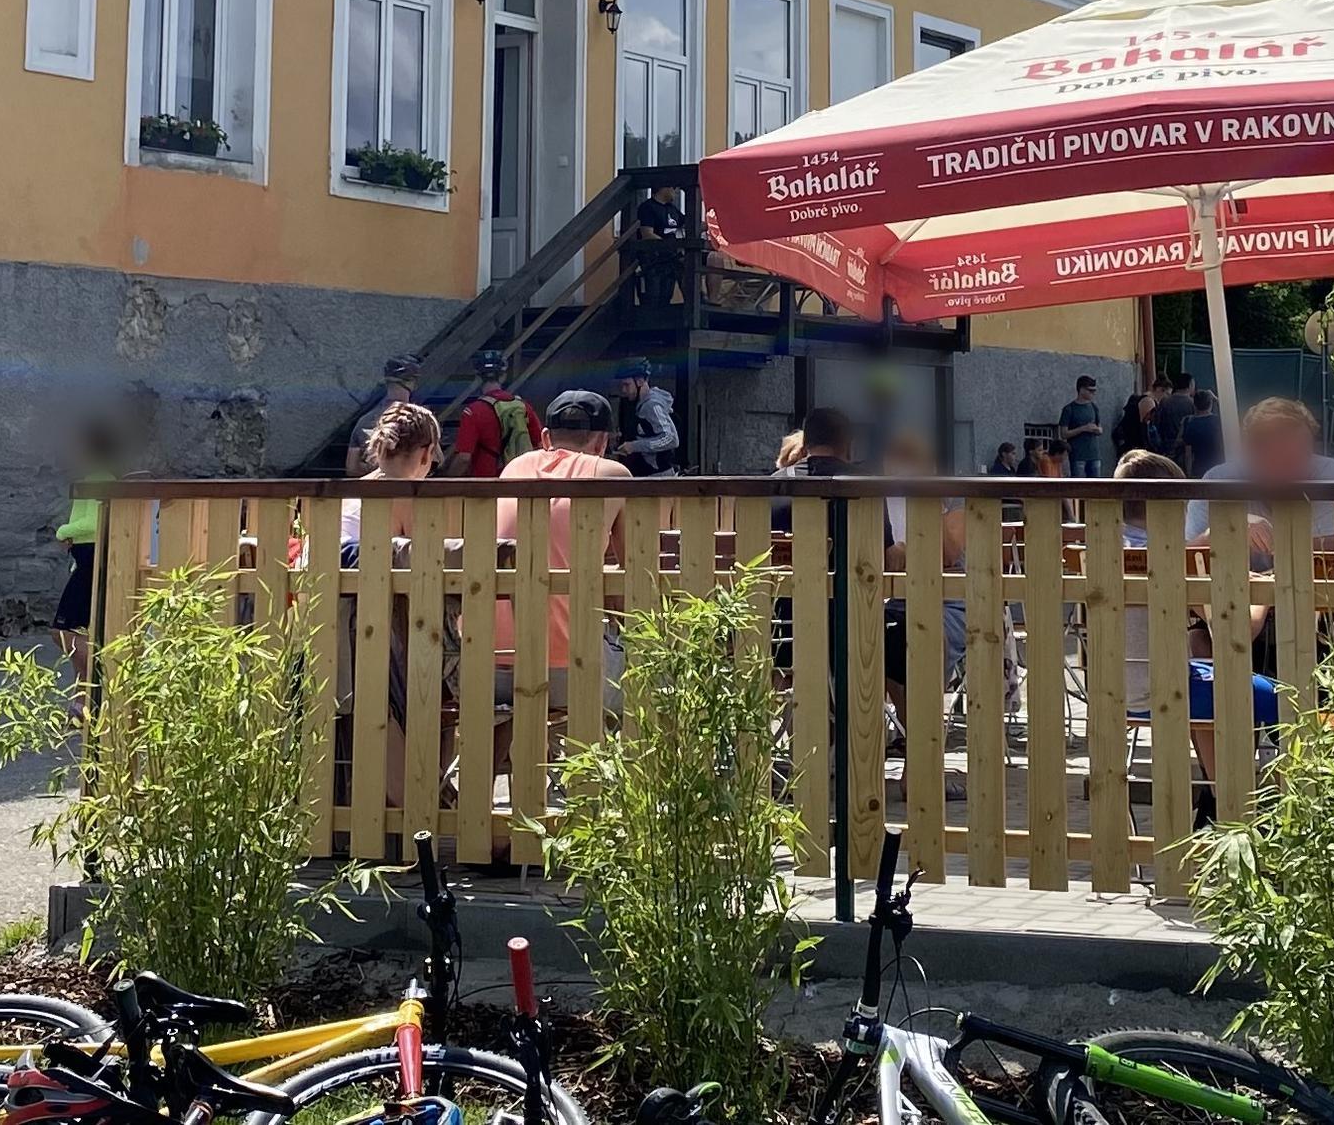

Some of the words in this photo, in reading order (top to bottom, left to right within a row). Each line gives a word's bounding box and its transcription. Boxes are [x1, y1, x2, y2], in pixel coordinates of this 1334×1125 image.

[1022, 37, 1327, 80] Bakalář
[1055, 69, 1165, 94] Dobré
[802, 151, 840, 168] 1454
[926, 130, 1057, 178] TRADIČNÍ
[1064, 121, 1187, 160] PIVOVAR
[1193, 120, 1214, 144] V
[767, 161, 880, 202] Bakalář
[789, 203, 828, 223] Dobré
